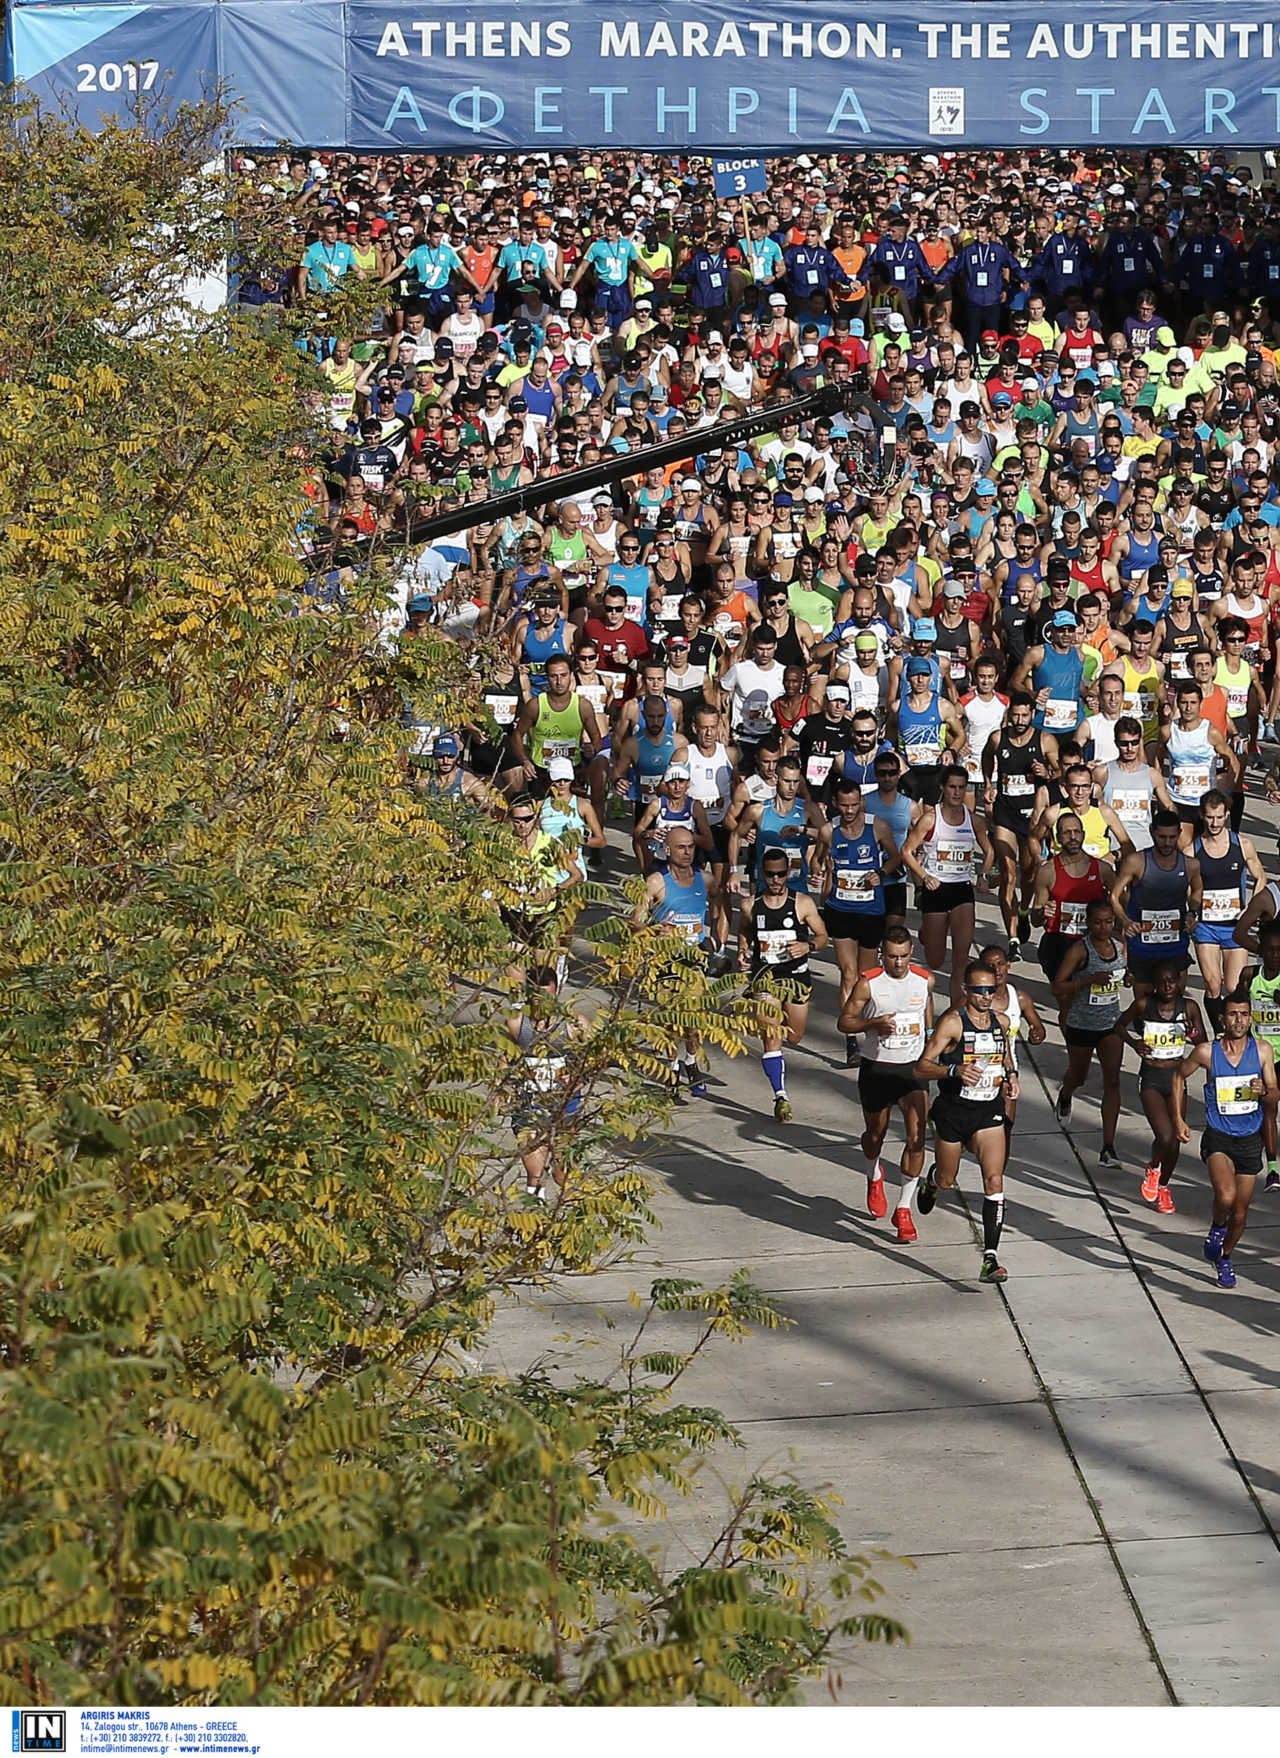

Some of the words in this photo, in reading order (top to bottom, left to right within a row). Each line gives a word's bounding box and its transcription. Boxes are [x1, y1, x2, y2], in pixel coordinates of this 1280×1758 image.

[376, 22, 572, 57] ATHENS
[600, 22, 902, 58] MARATHON.
[918, 23, 1012, 58] THE
[77, 62, 159, 91] 2017
[716, 159, 760, 174] BLOCK
[734, 174, 747, 191] 3
[551, 748, 570, 757] 208
[1151, 921, 1171, 931] 205
[1260, 1010, 1280, 1021] 101
[1154, 1034, 1176, 1046] 104
[1234, 1088, 1242, 1099] 5
